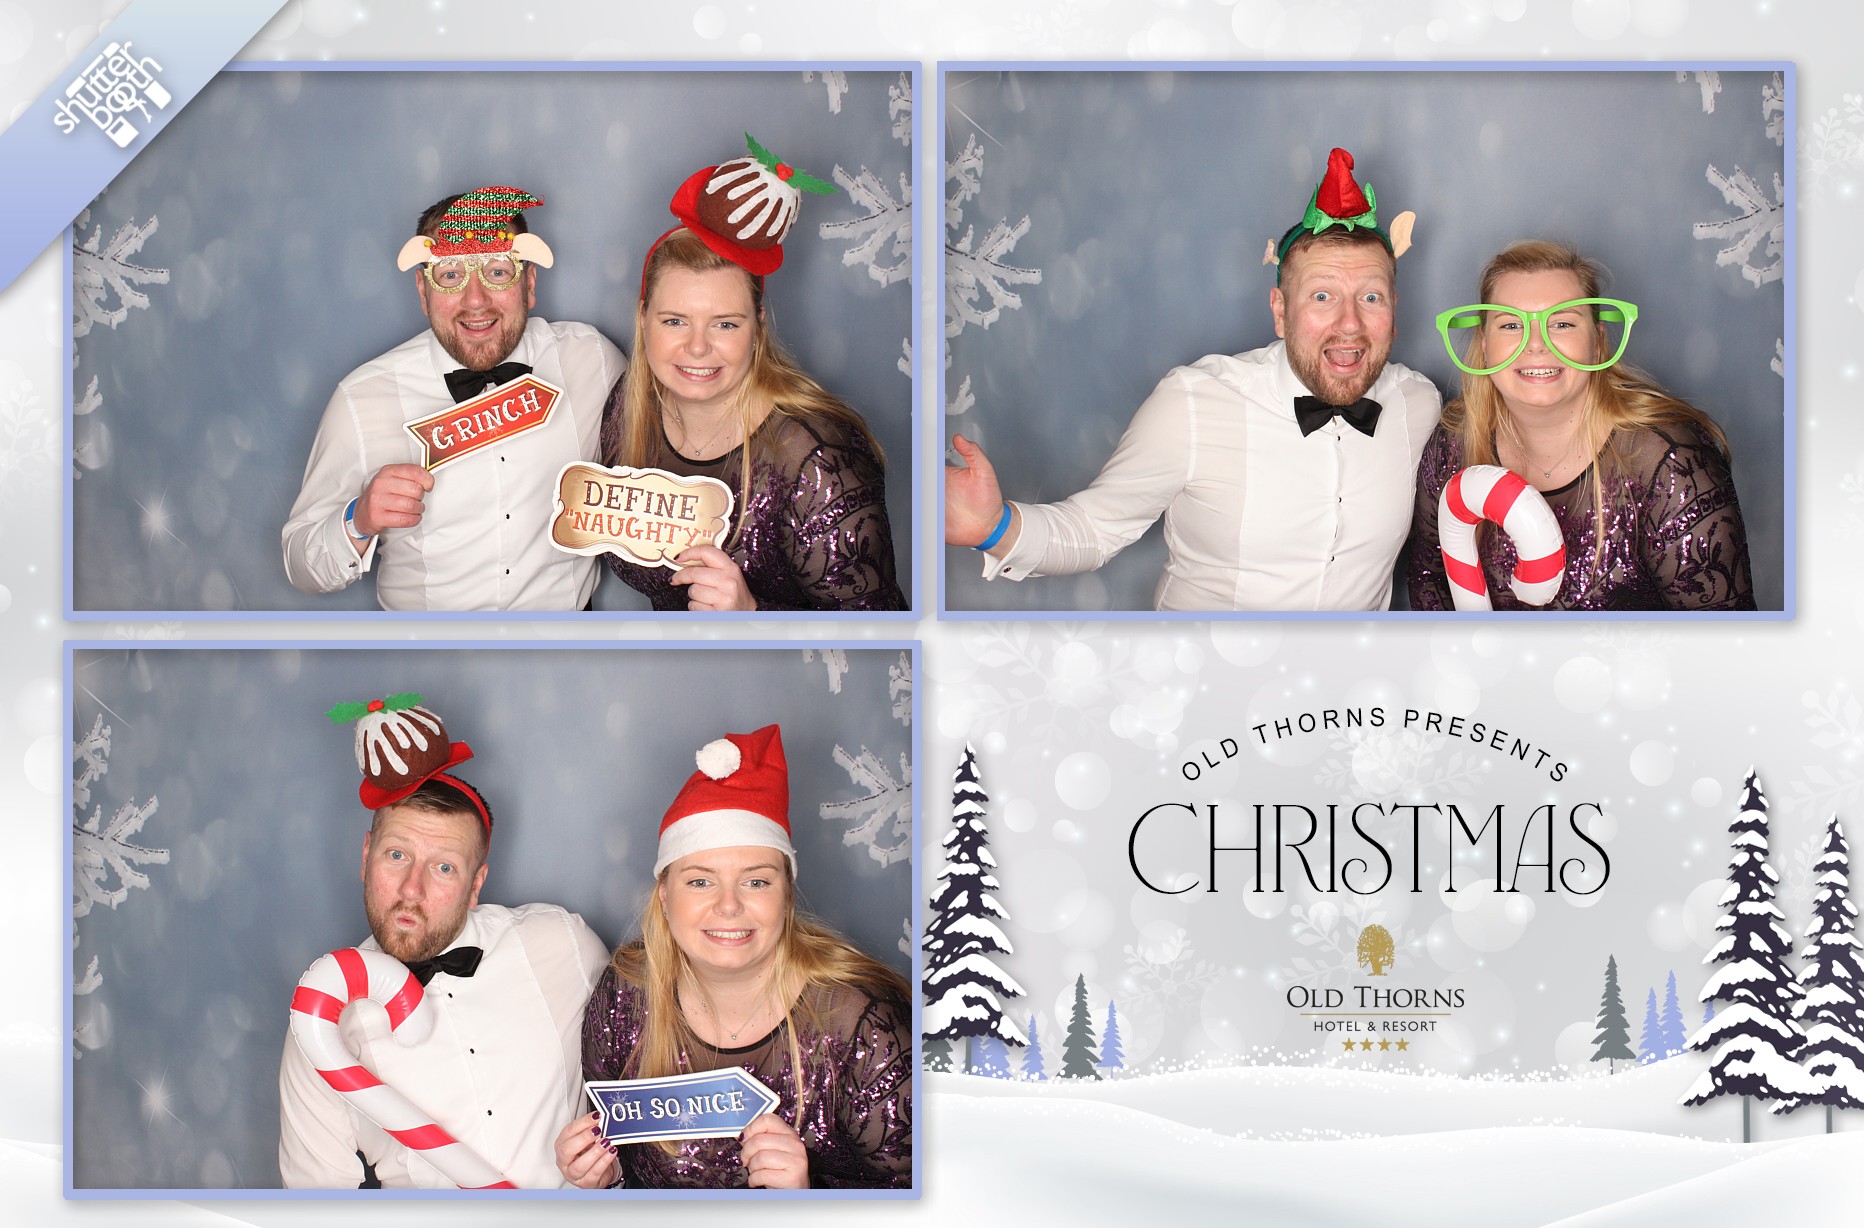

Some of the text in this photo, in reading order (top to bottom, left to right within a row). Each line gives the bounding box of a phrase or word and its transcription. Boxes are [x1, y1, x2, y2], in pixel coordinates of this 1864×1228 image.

[431, 388, 542, 449] GRINCH
[583, 480, 699, 521] DEFINE
[565, 508, 712, 548] "NAUGHTY"
[611, 1091, 745, 1122] OH SO NICE
